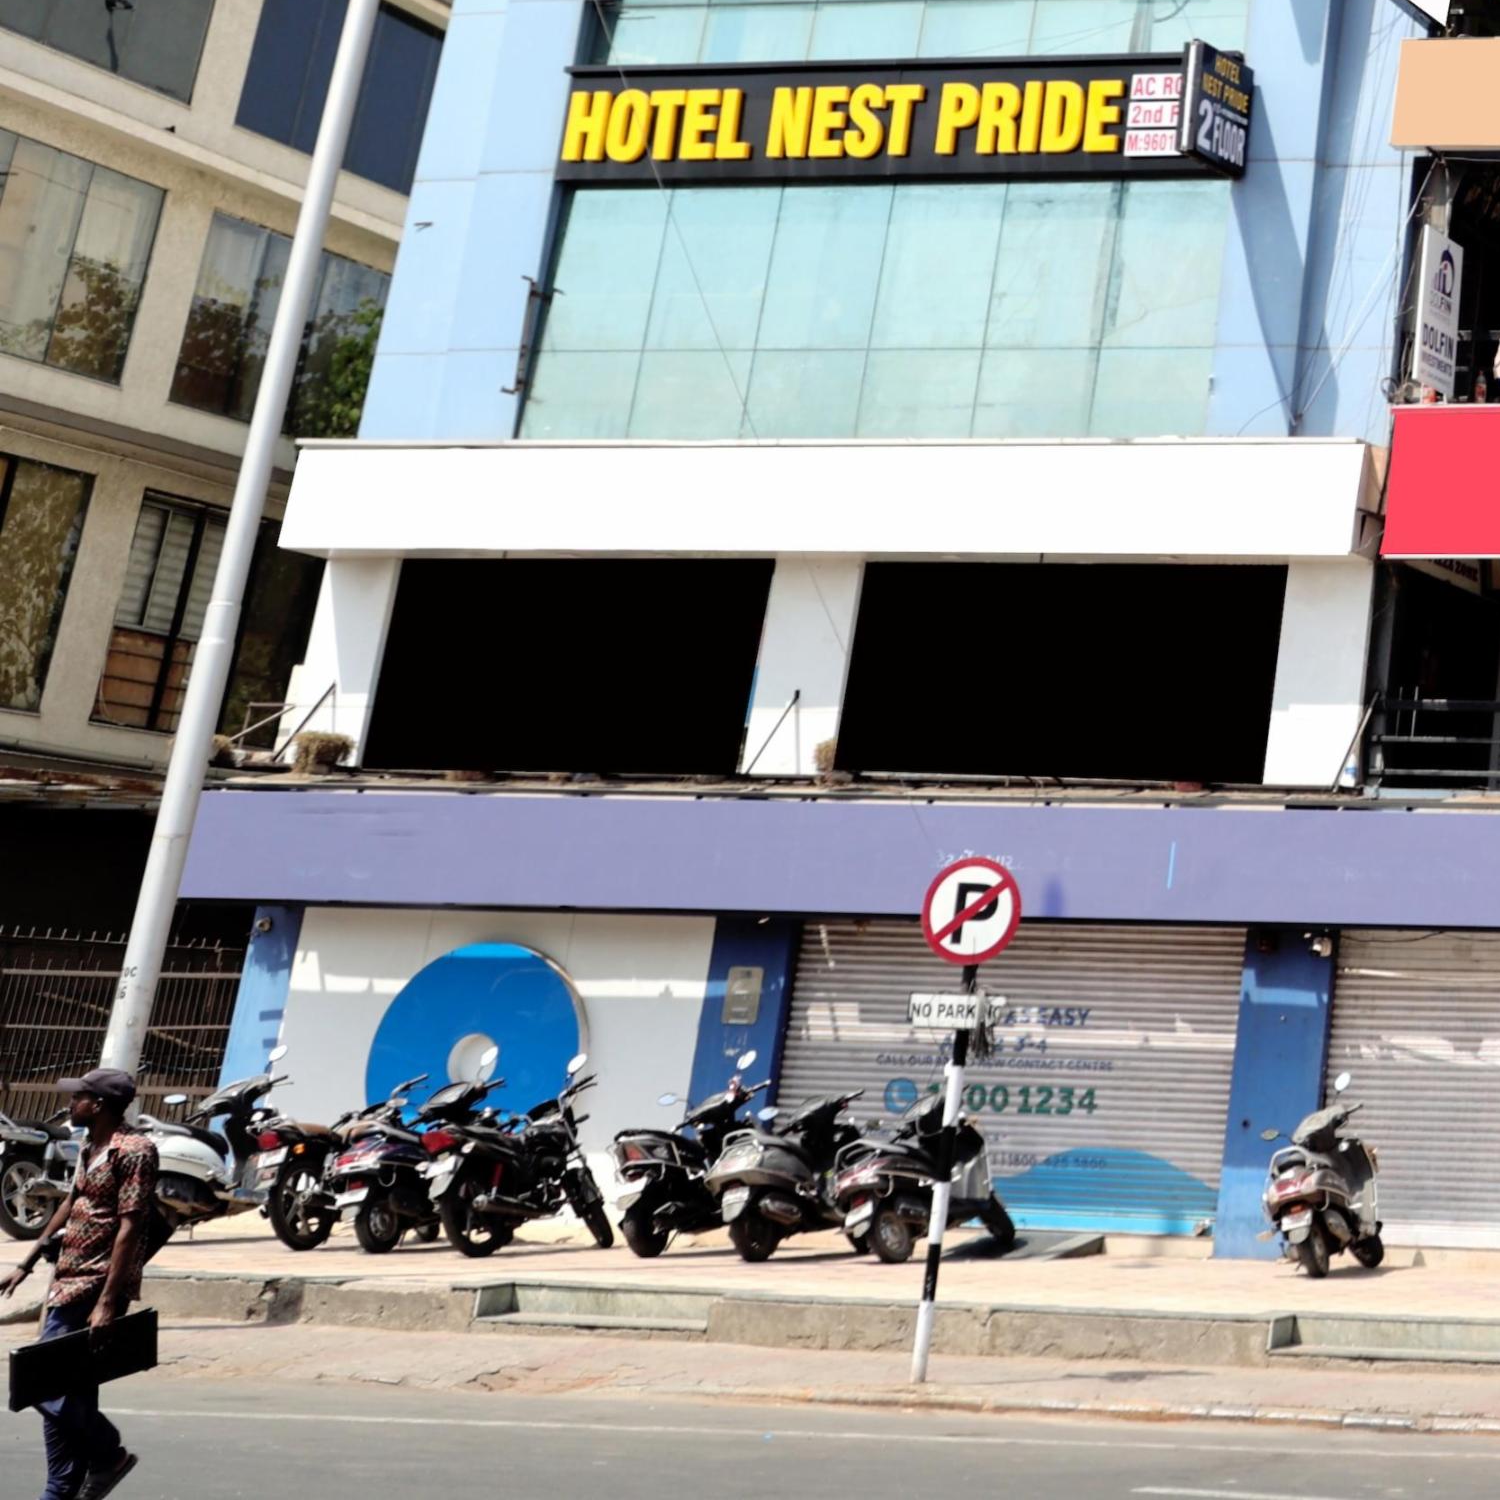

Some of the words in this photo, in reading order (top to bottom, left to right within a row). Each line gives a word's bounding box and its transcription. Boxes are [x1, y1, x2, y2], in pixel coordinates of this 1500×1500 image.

[1215, 55, 1240, 84] HOTEL
[1133, 76, 1156, 96] AC
[1203, 72, 1223, 100] NEST
[1223, 84, 1249, 114] PRIDE
[561, 88, 750, 164] HOTEL
[766, 83, 924, 160] NEST
[935, 78, 1127, 155] PRIDE
[1132, 105, 1163, 124] 2nd
[1212, 115, 1245, 167] FLOOR
[1422, 322, 1455, 361] DOLFIN
[911, 1004, 932, 1019] NO
[1038, 1008, 1093, 1026] EASY
[876, 1054, 906, 1066] CALL
[1007, 1058, 1066, 1071] CONTACT
[1069, 1059, 1114, 1072] CENTRE
[1017, 1086, 1098, 1115] 1234
